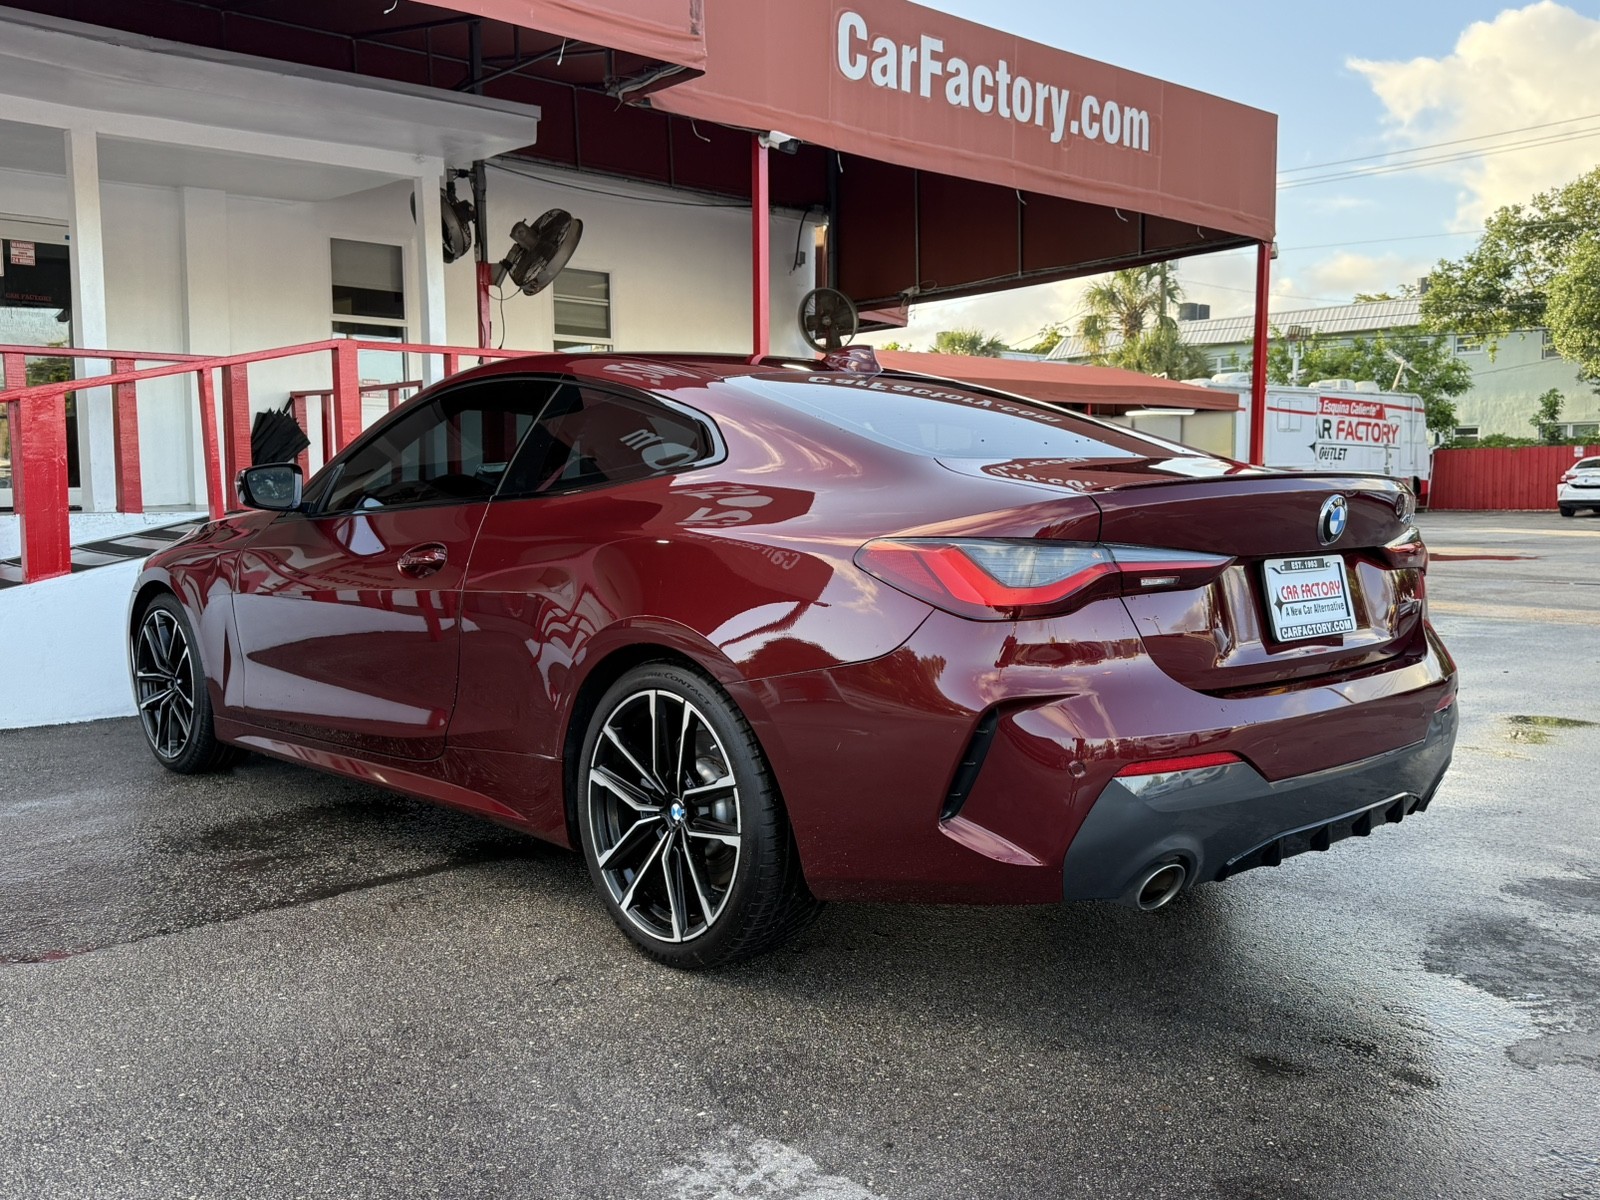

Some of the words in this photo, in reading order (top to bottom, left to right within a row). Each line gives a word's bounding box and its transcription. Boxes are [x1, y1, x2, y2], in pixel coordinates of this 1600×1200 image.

[837, 11, 1149, 151] CarFactory.com
[1323, 400, 1349, 415] Esquina
[1336, 420, 1399, 444] FACTORY
[1319, 446, 1347, 461] OUTLET
[1291, 561, 1304, 570] EST.
[1304, 560, 1318, 569] 1993
[1281, 585, 1299, 600] CAR
[1301, 580, 1340, 599] FACTORY
[1285, 607, 1290, 617] A
[1290, 605, 1302, 616] New
[1302, 604, 1313, 615] Car
[1313, 601, 1345, 614] Alternative
[1281, 619, 1352, 639] CARFACTORY.COM
